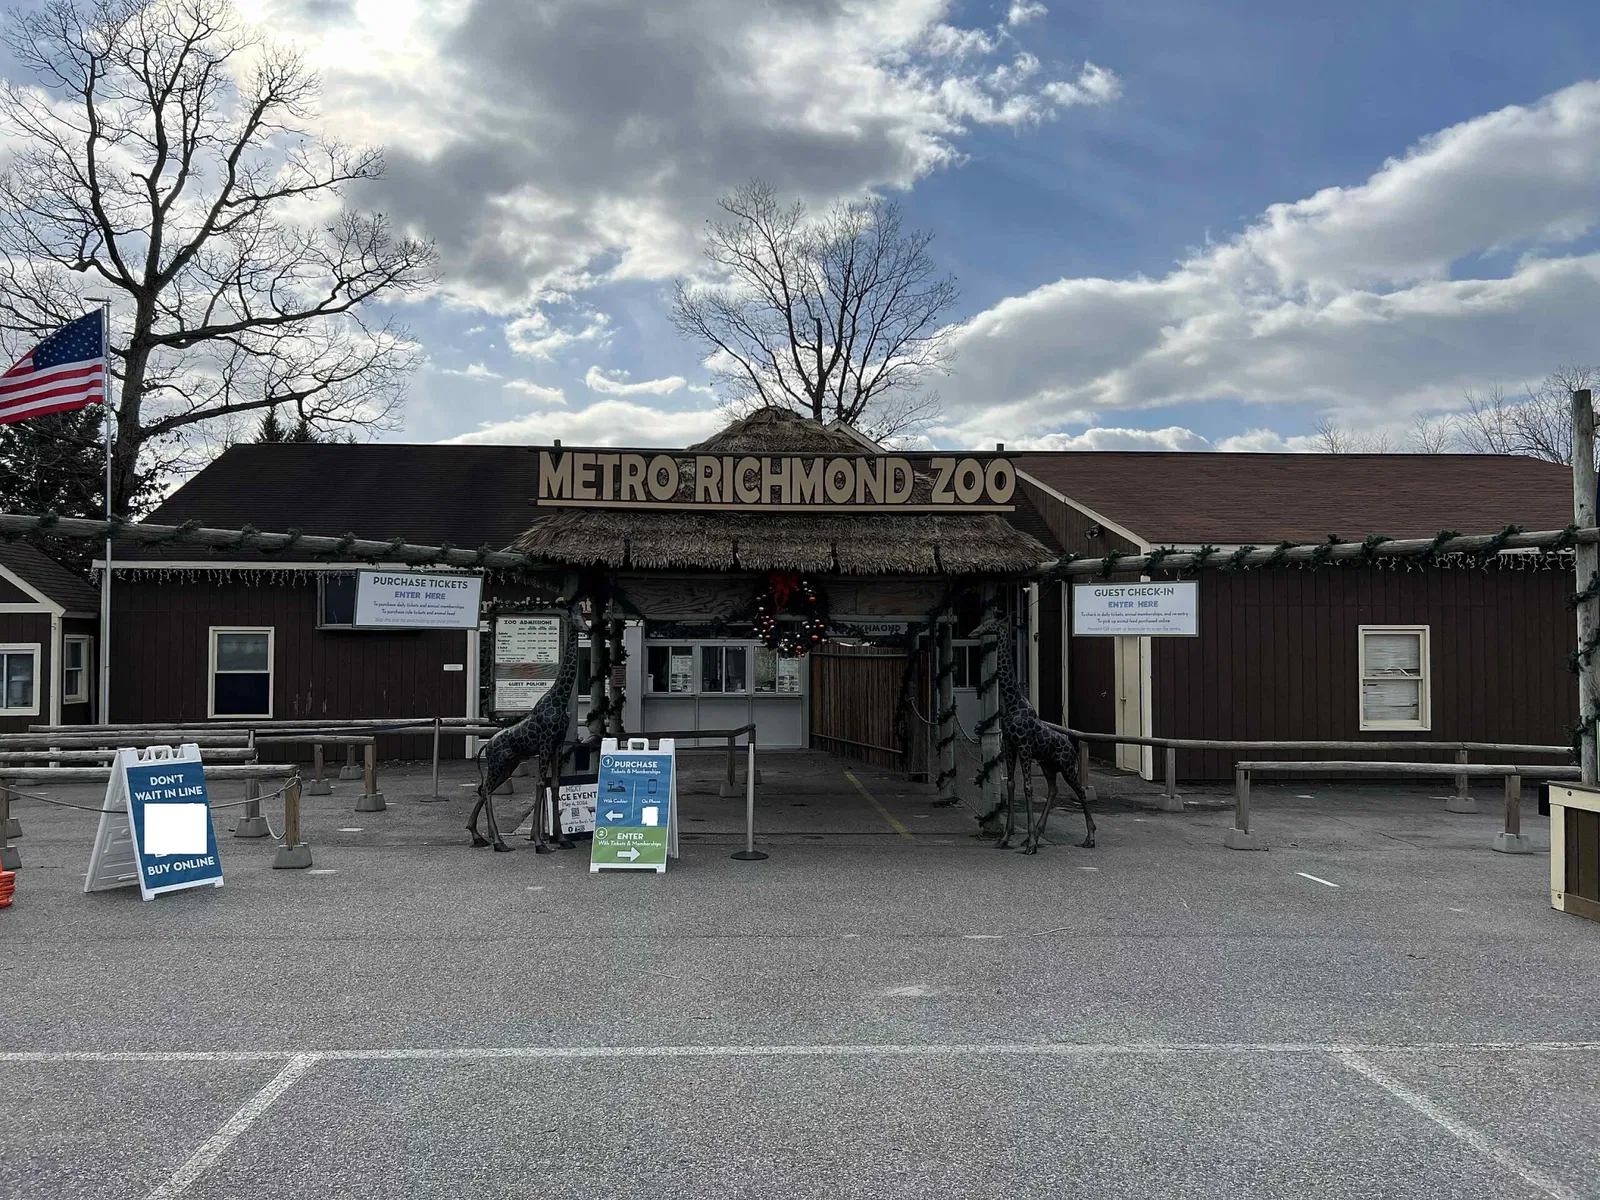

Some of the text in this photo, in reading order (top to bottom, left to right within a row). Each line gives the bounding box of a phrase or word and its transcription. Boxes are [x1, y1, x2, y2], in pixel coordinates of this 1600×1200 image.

[538, 451, 1017, 505] METRO RICHMOND ZOO
[373, 576, 468, 589] PURCHASE TICKETS
[394, 591, 446, 600] ENTER HERE
[1094, 587, 1174, 597] GUEST CHECK-IN
[1138, 600, 1159, 608] HERE
[149, 774, 184, 786] DON'T
[135, 785, 204, 801] WAIT IN LINE
[573, 792, 598, 800] EVENT
[617, 832, 644, 840] ENTER
[147, 856, 215, 876] BUY ONLINE
